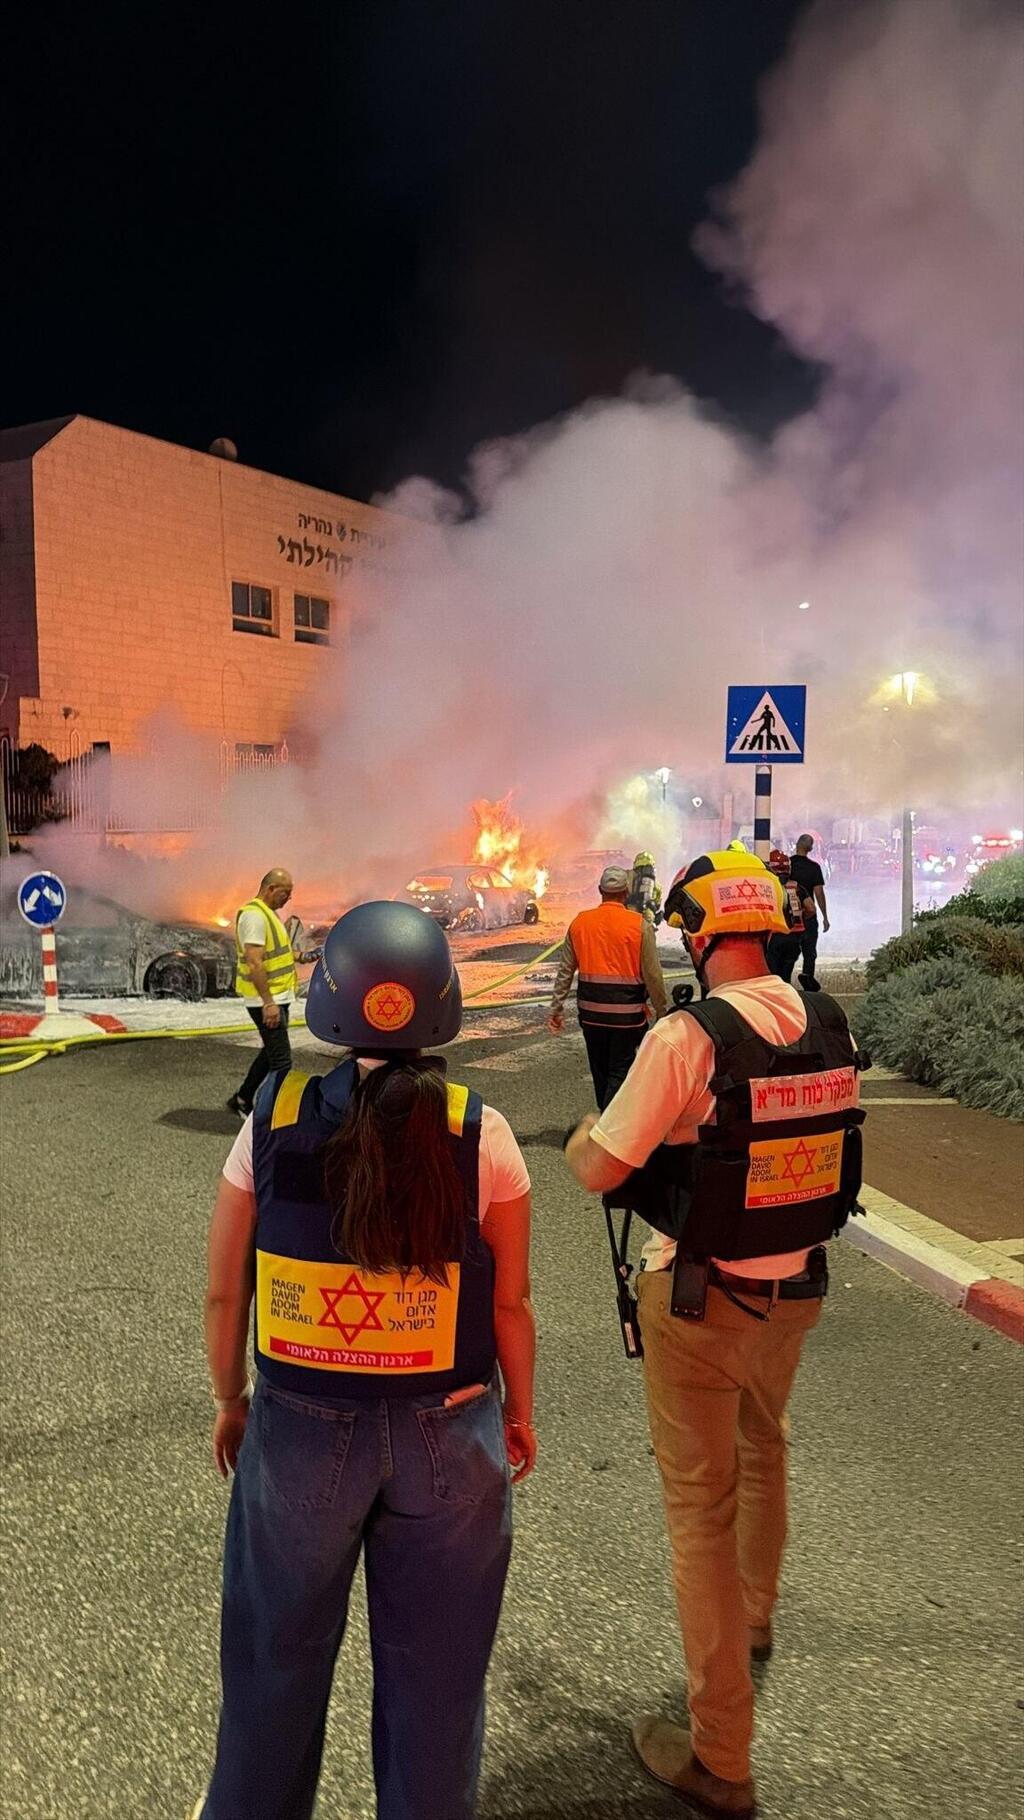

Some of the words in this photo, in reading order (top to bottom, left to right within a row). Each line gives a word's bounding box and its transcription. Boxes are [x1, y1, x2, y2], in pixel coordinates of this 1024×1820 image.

[298, 513, 333, 535] נהריה
[277, 535, 353, 578] קהילתי
[756, 1086, 797, 1109] מד"א
[752, 1154, 775, 1162] MAGEN
[751, 1169, 771, 1177] ADOM
[759, 1174, 778, 1183] ISRAEL
[271, 1278, 306, 1294] MAGEN
[271, 1287, 300, 1302] DAVID
[393, 1291, 413, 1305] דוד
[418, 1290, 437, 1305] מגן
[271, 1298, 300, 1313] ADOM
[406, 1304, 436, 1317] אדום
[271, 1307, 280, 1318] IN
[283, 1310, 313, 1325] ISRAEL
[388, 1318, 435, 1331] בישראל
[287, 1343, 329, 1361] הלאומי
[332, 1350, 377, 1365] ההצלה
[380, 1355, 414, 1368] ארגון
